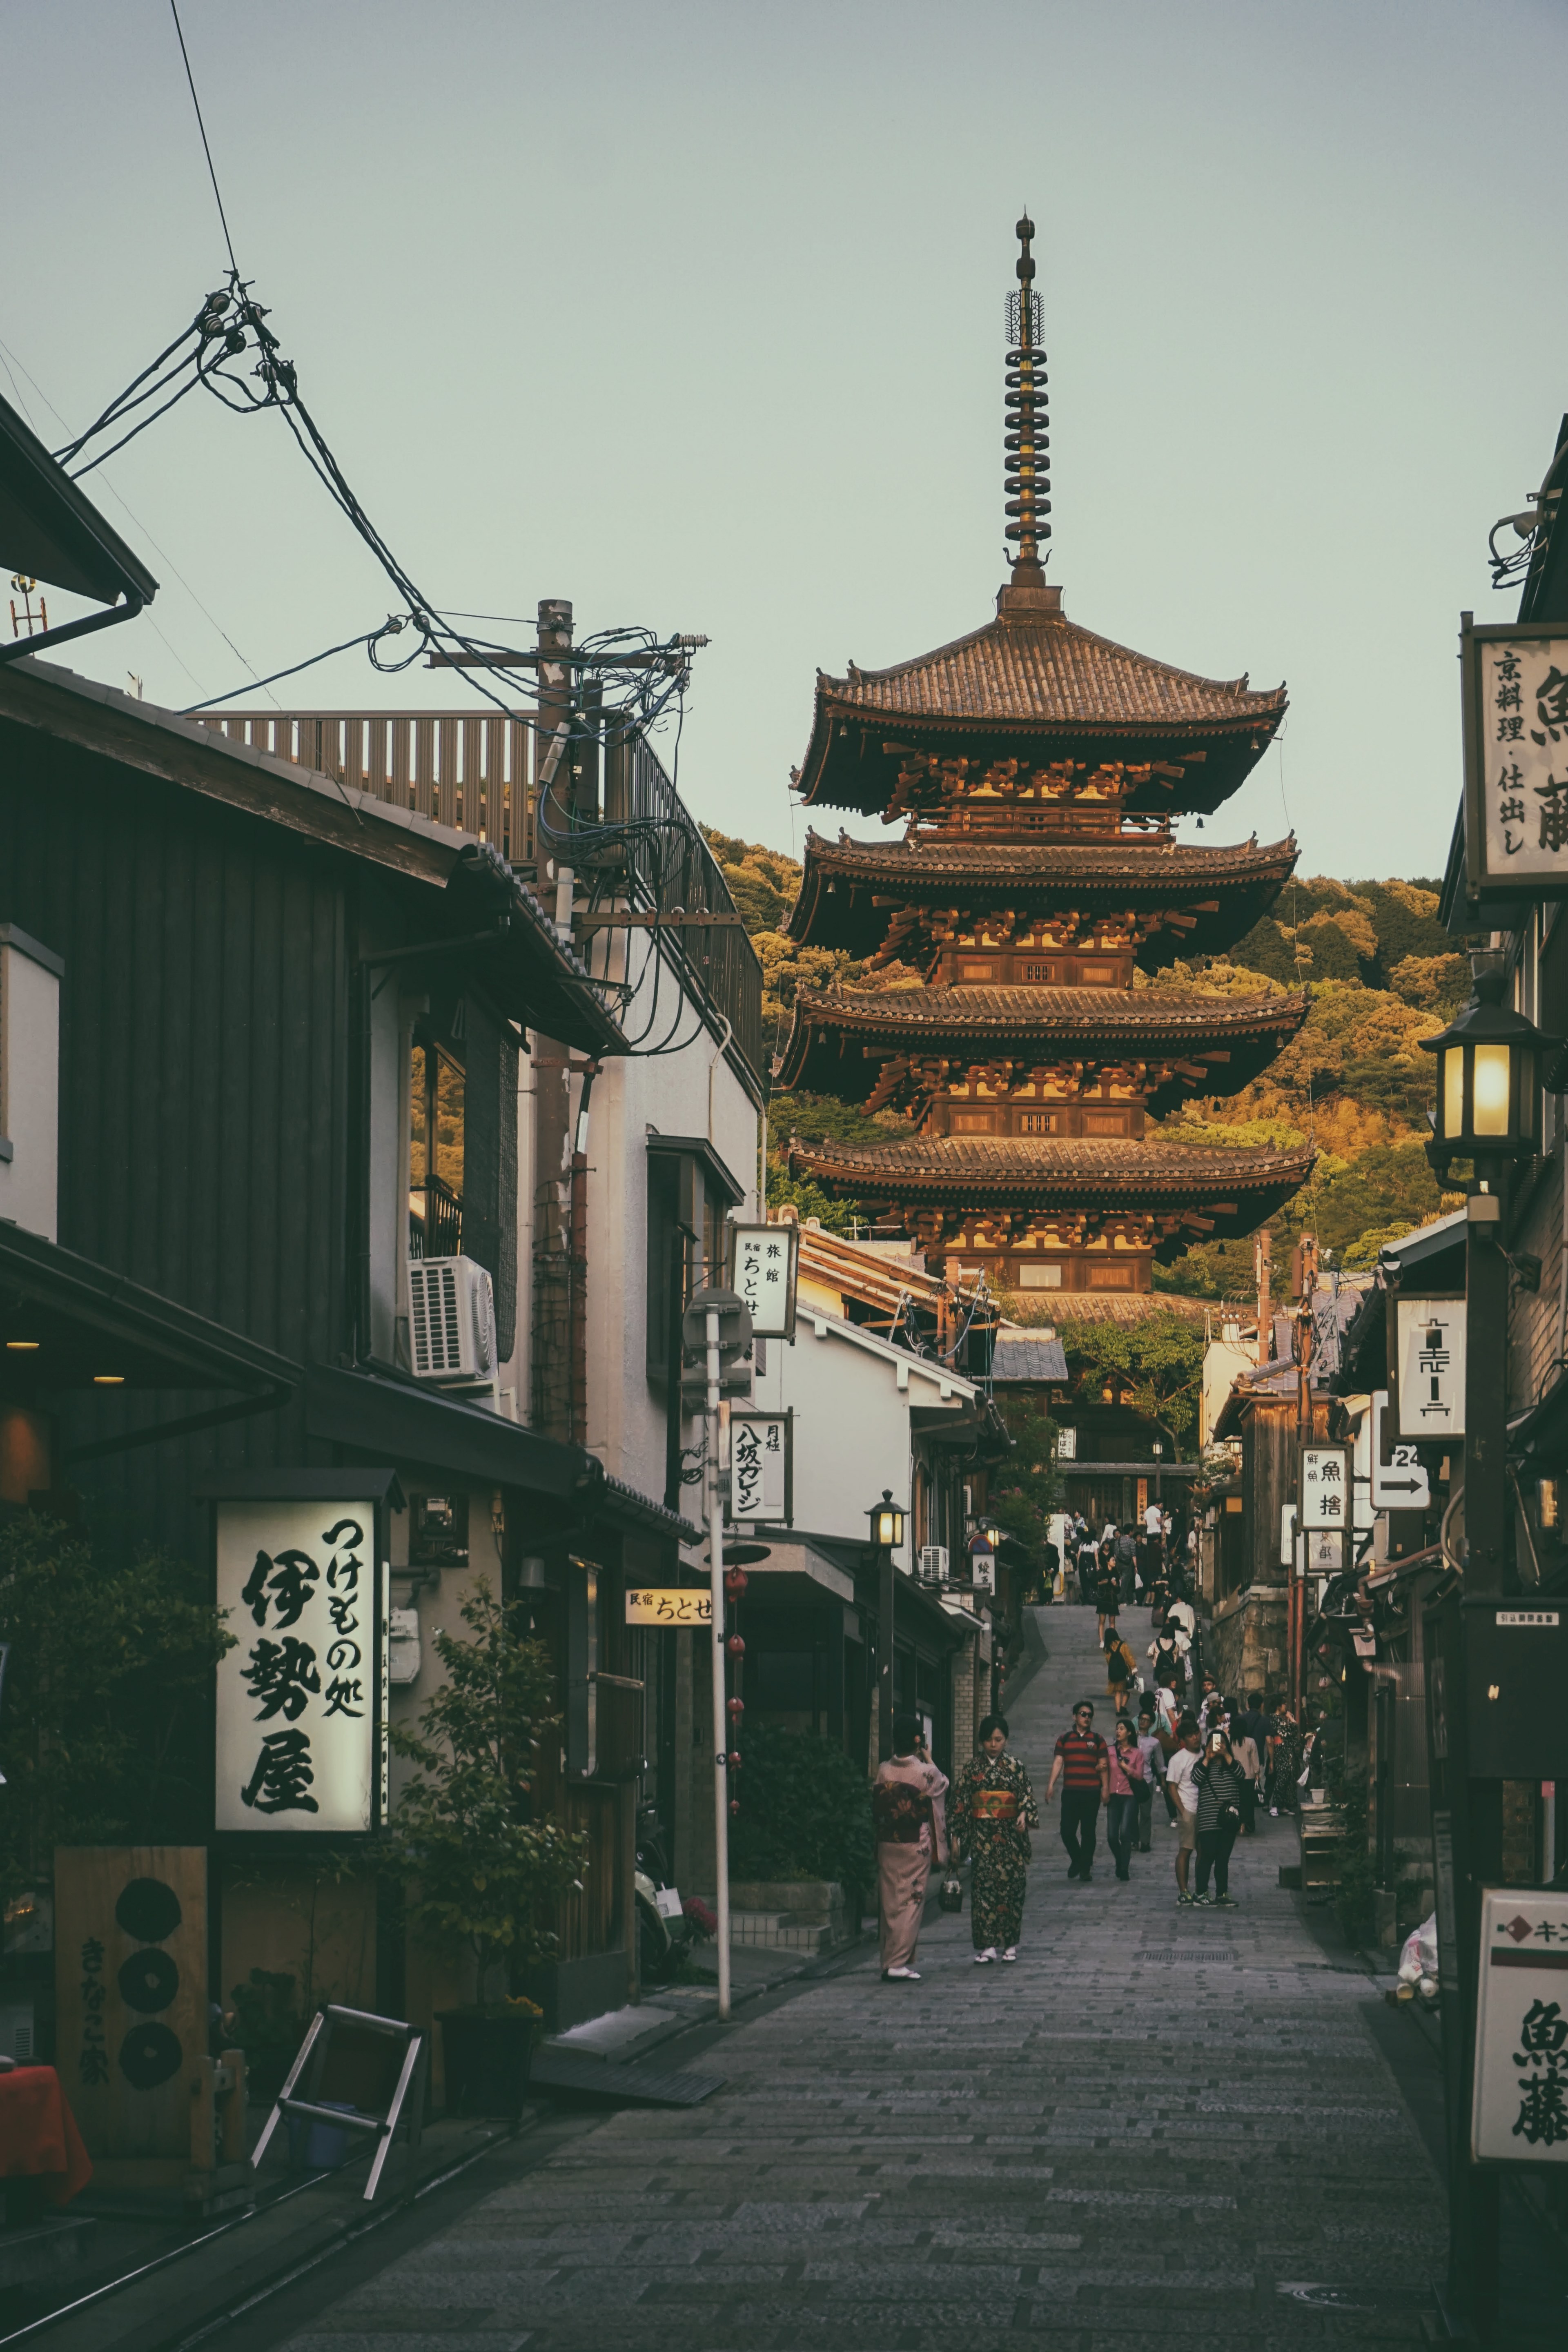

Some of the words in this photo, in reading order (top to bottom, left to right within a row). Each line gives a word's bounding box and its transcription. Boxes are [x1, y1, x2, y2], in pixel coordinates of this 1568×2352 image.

[745, 1243, 761, 1252] 民宿
[766, 1244, 782, 1283] 旅館
[744, 1256, 760, 1316] ちとせ
[766, 1424, 780, 1452] 月極
[735, 1423, 763, 1512] 八坂ガレージ
[1307, 1453, 1319, 1482] 鮮魚
[1319, 1461, 1341, 1516] 魚捨
[322, 1518, 366, 1718] つけもの処
[240, 1549, 321, 1814] 伊勢屋
[79, 1936, 110, 2085] きなこ家
